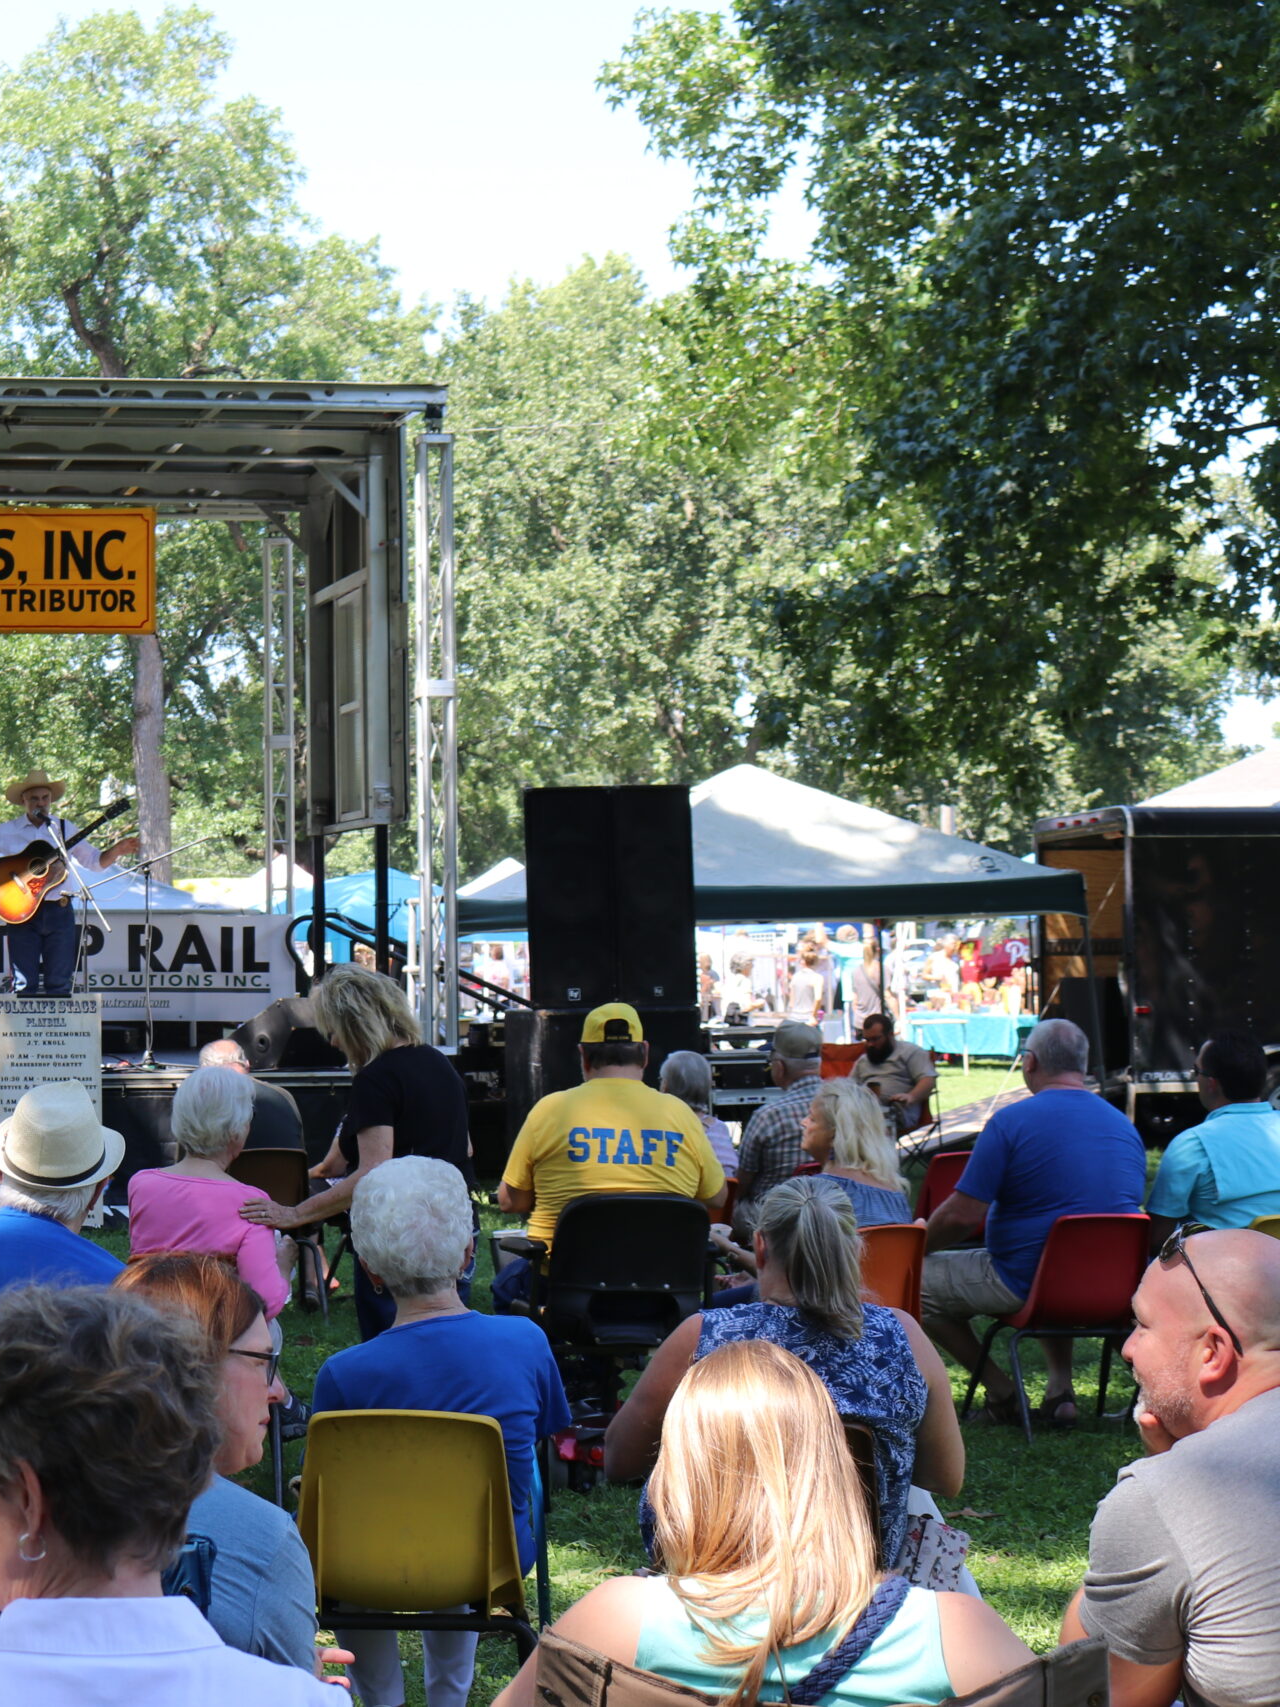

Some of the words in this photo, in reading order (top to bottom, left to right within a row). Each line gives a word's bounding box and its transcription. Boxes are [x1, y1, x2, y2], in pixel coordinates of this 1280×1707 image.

[43, 529, 137, 582] INC.
[127, 925, 270, 973] RAIL
[89, 974, 213, 987] SOLUTIONS
[225, 974, 270, 987] INC.
[58, 1000, 97, 1014] STAGE
[26, 1018, 67, 1028] PLAYBILL
[568, 1127, 684, 1167] STAFF
